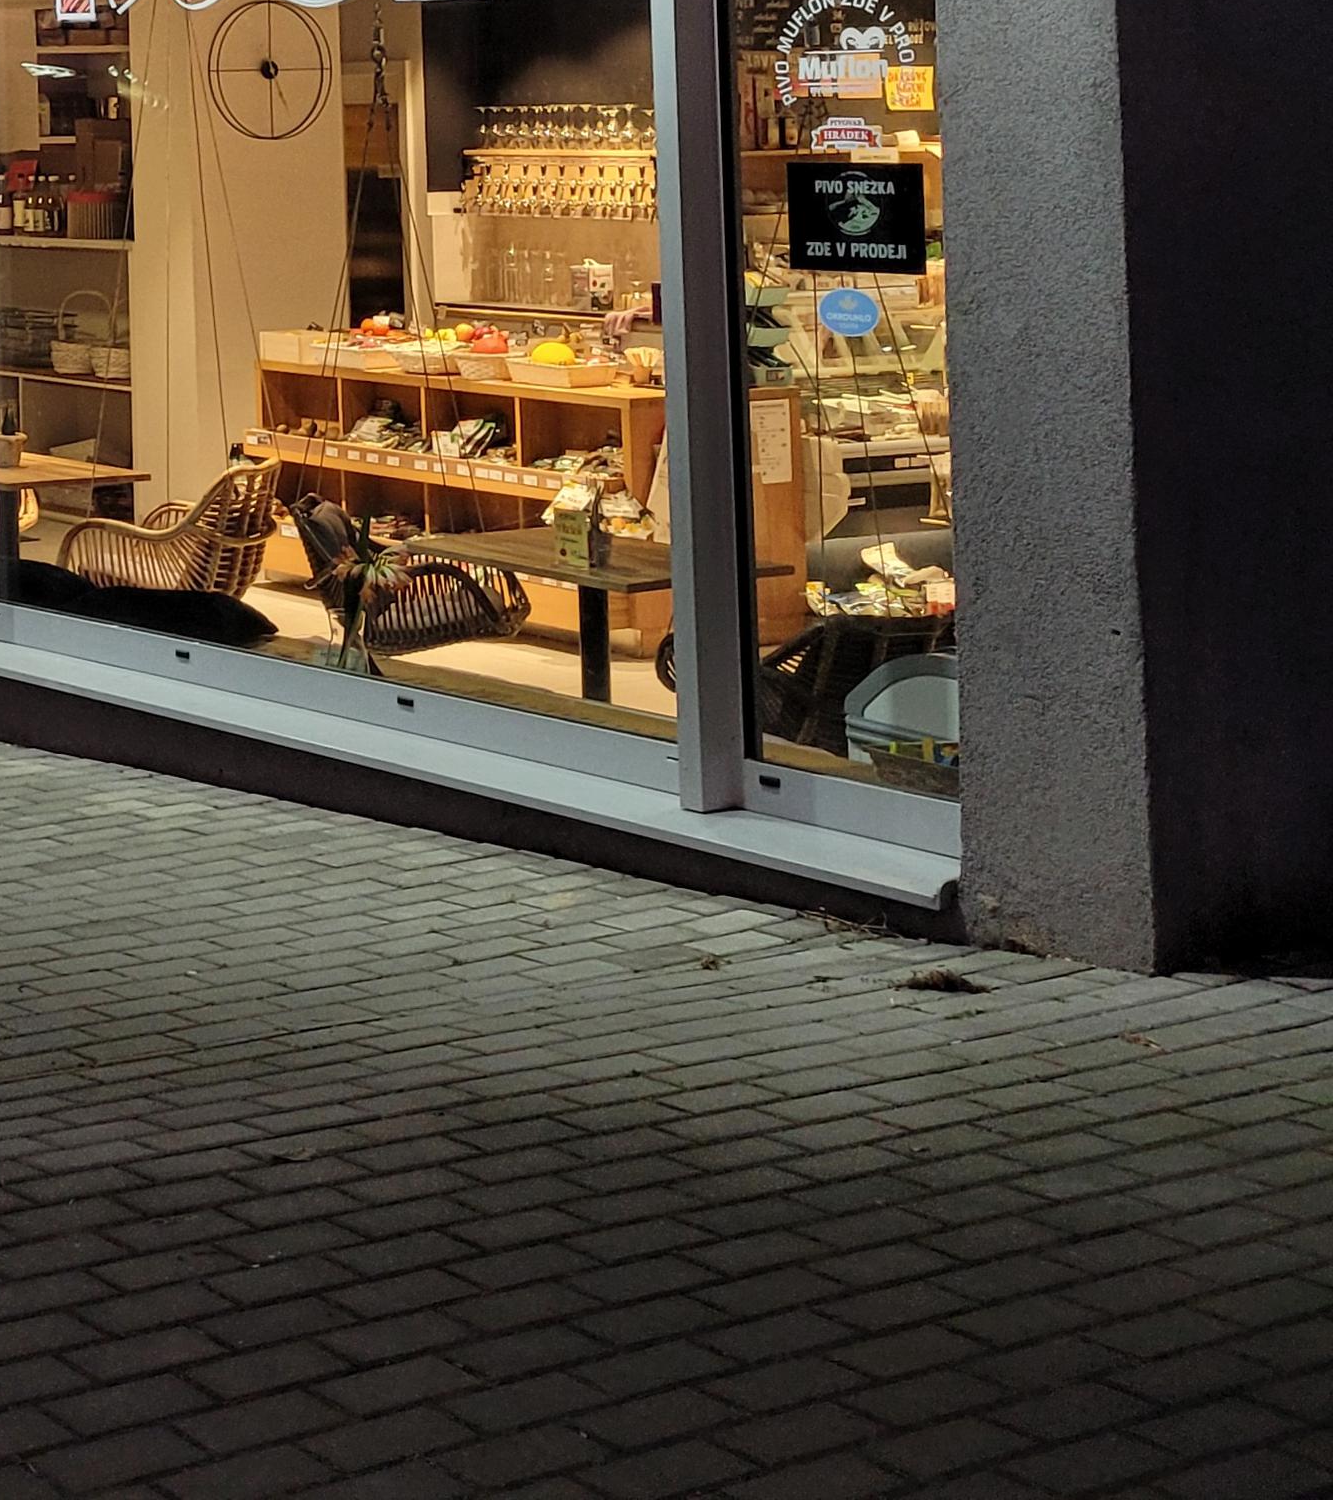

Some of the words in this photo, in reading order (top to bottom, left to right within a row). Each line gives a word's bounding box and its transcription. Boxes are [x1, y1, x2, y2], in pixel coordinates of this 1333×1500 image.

[775, 60, 798, 107] PIVO
[878, 5, 895, 22] V
[814, 180, 843, 195] PIVO
[806, 241, 832, 256] ZDE
[835, 242, 847, 257] V
[850, 243, 908, 260] PRODEJI
